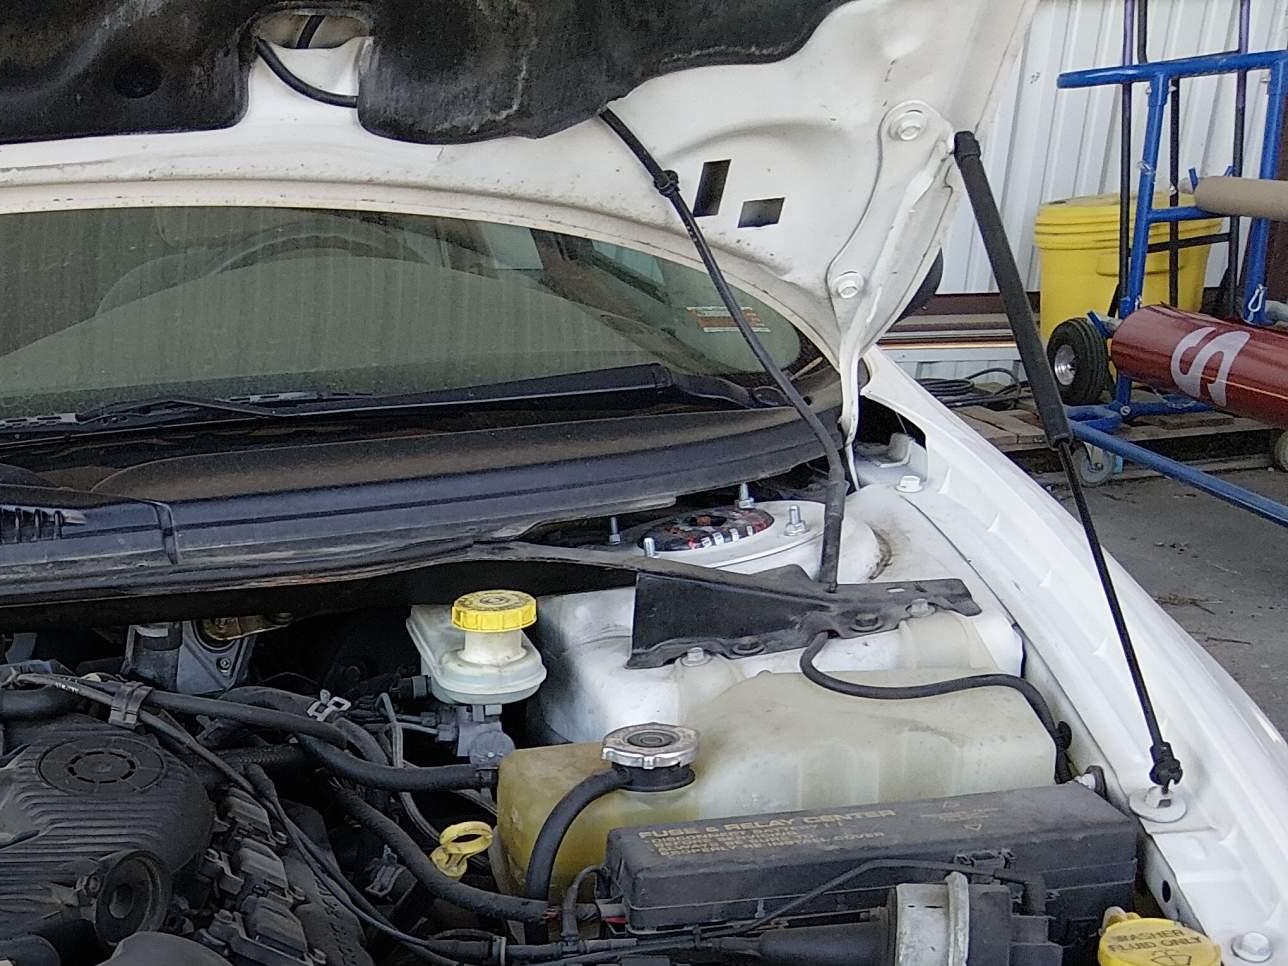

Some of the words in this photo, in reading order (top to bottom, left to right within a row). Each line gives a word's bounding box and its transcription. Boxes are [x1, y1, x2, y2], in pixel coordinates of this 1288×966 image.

[638, 827, 699, 839] FUSE
[724, 818, 794, 831] RELAY
[803, 809, 897, 823] CENTER
[1108, 941, 1157, 952] FLUID
[1160, 936, 1203, 947] ONLY
[1112, 930, 1185, 942] WASHER
